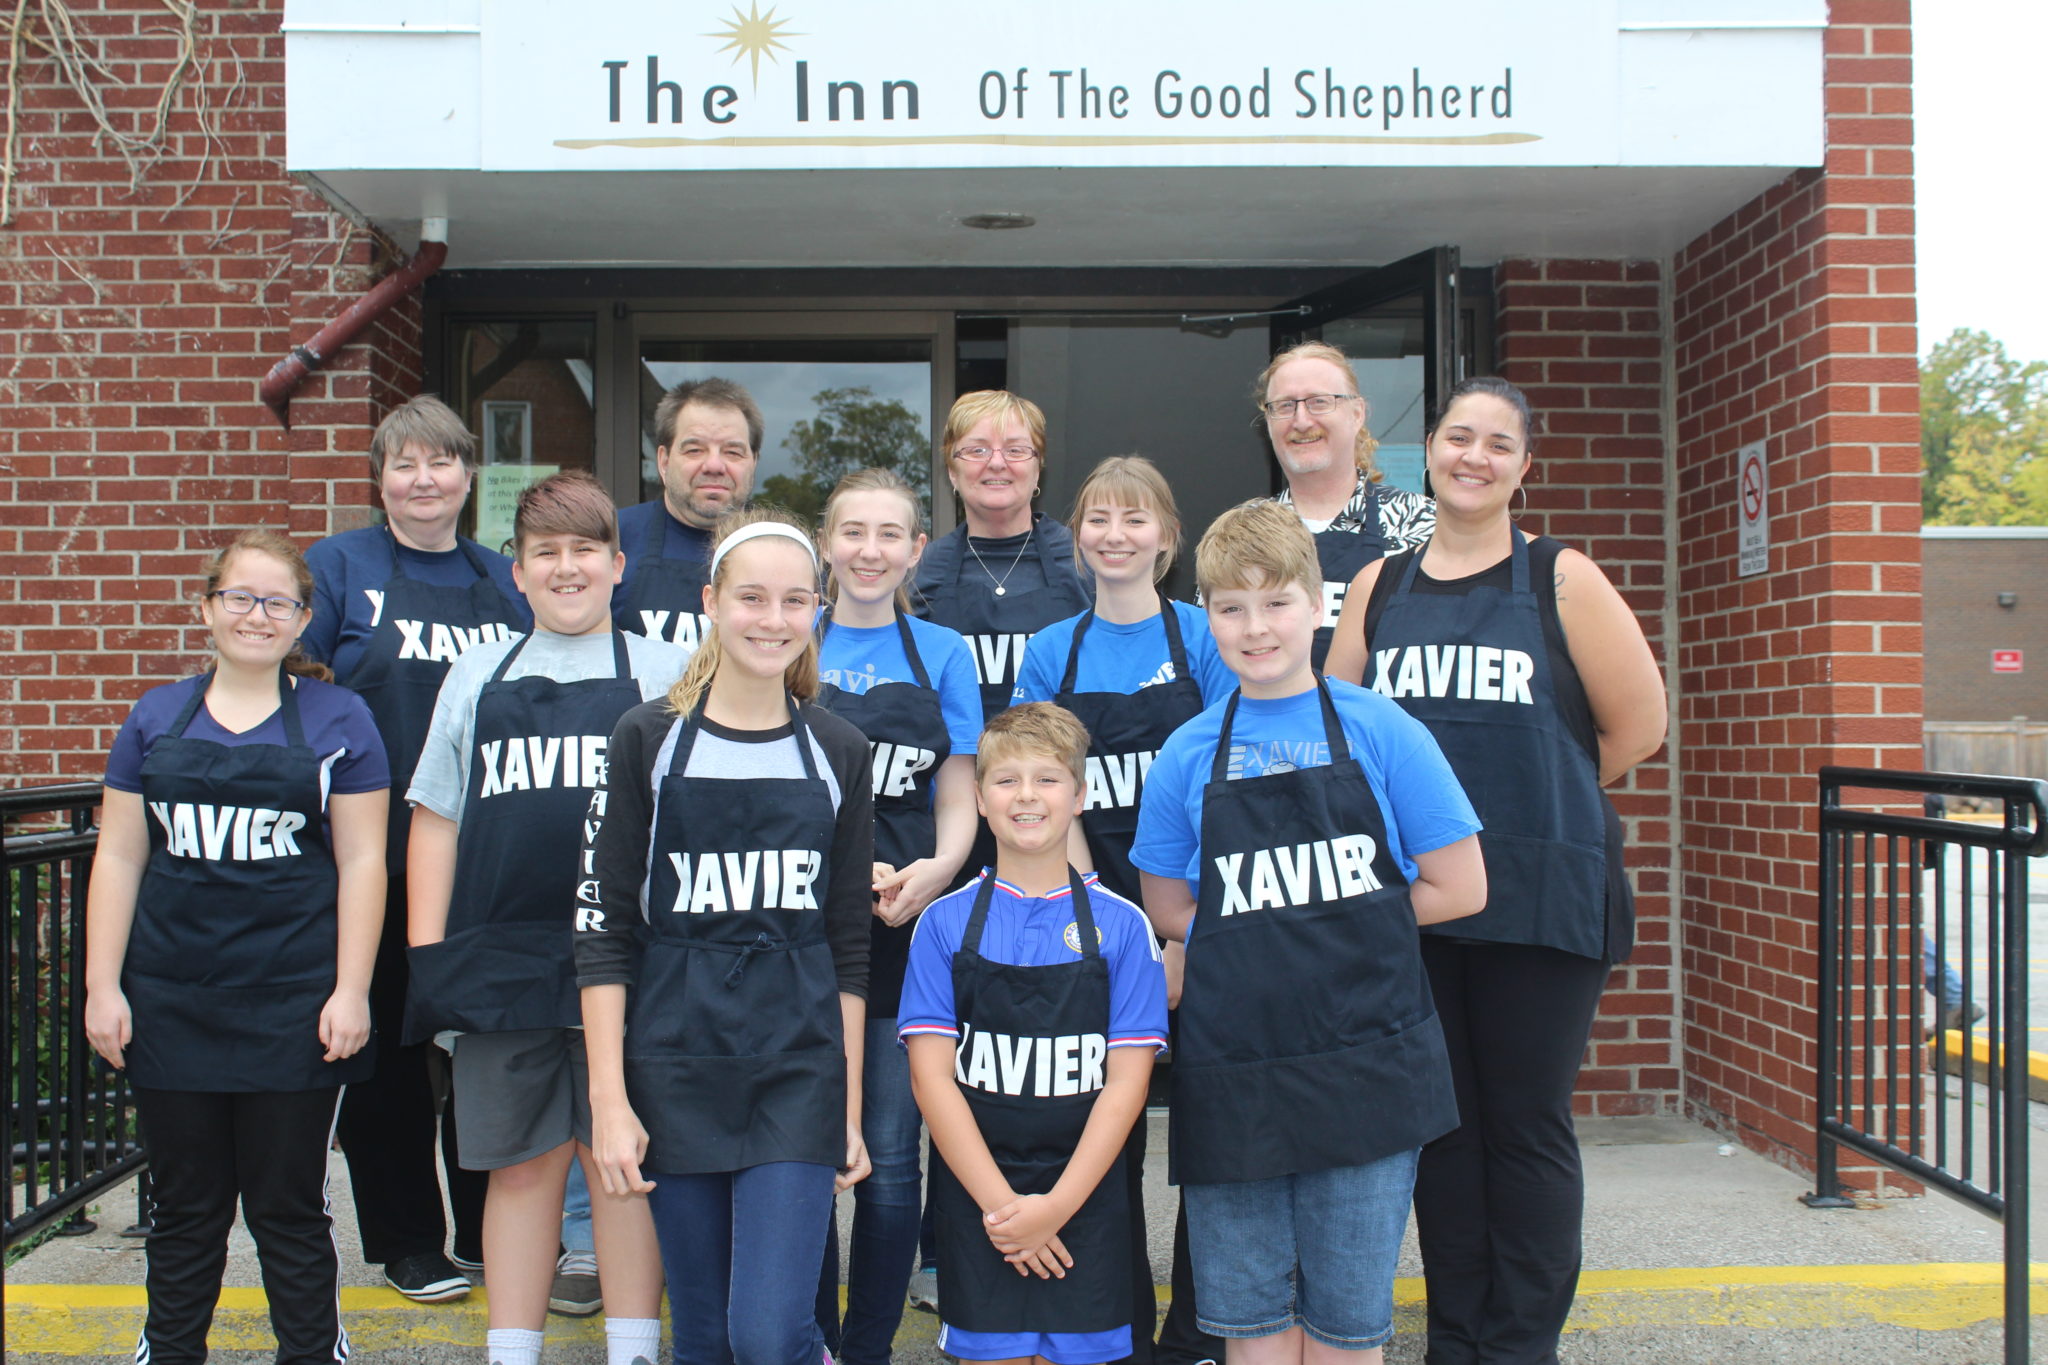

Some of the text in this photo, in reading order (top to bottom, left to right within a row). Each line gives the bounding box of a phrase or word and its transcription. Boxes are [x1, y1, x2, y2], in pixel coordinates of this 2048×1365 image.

[602, 55, 1513, 130] The Inn Of The Good Shepherd
[1372, 645, 1534, 705] XAVIER
[481, 735, 612, 799] XAVIE
[149, 802, 307, 861] XAVIER
[668, 850, 822, 914] XAVIER
[1214, 834, 1384, 917] XAVIER
